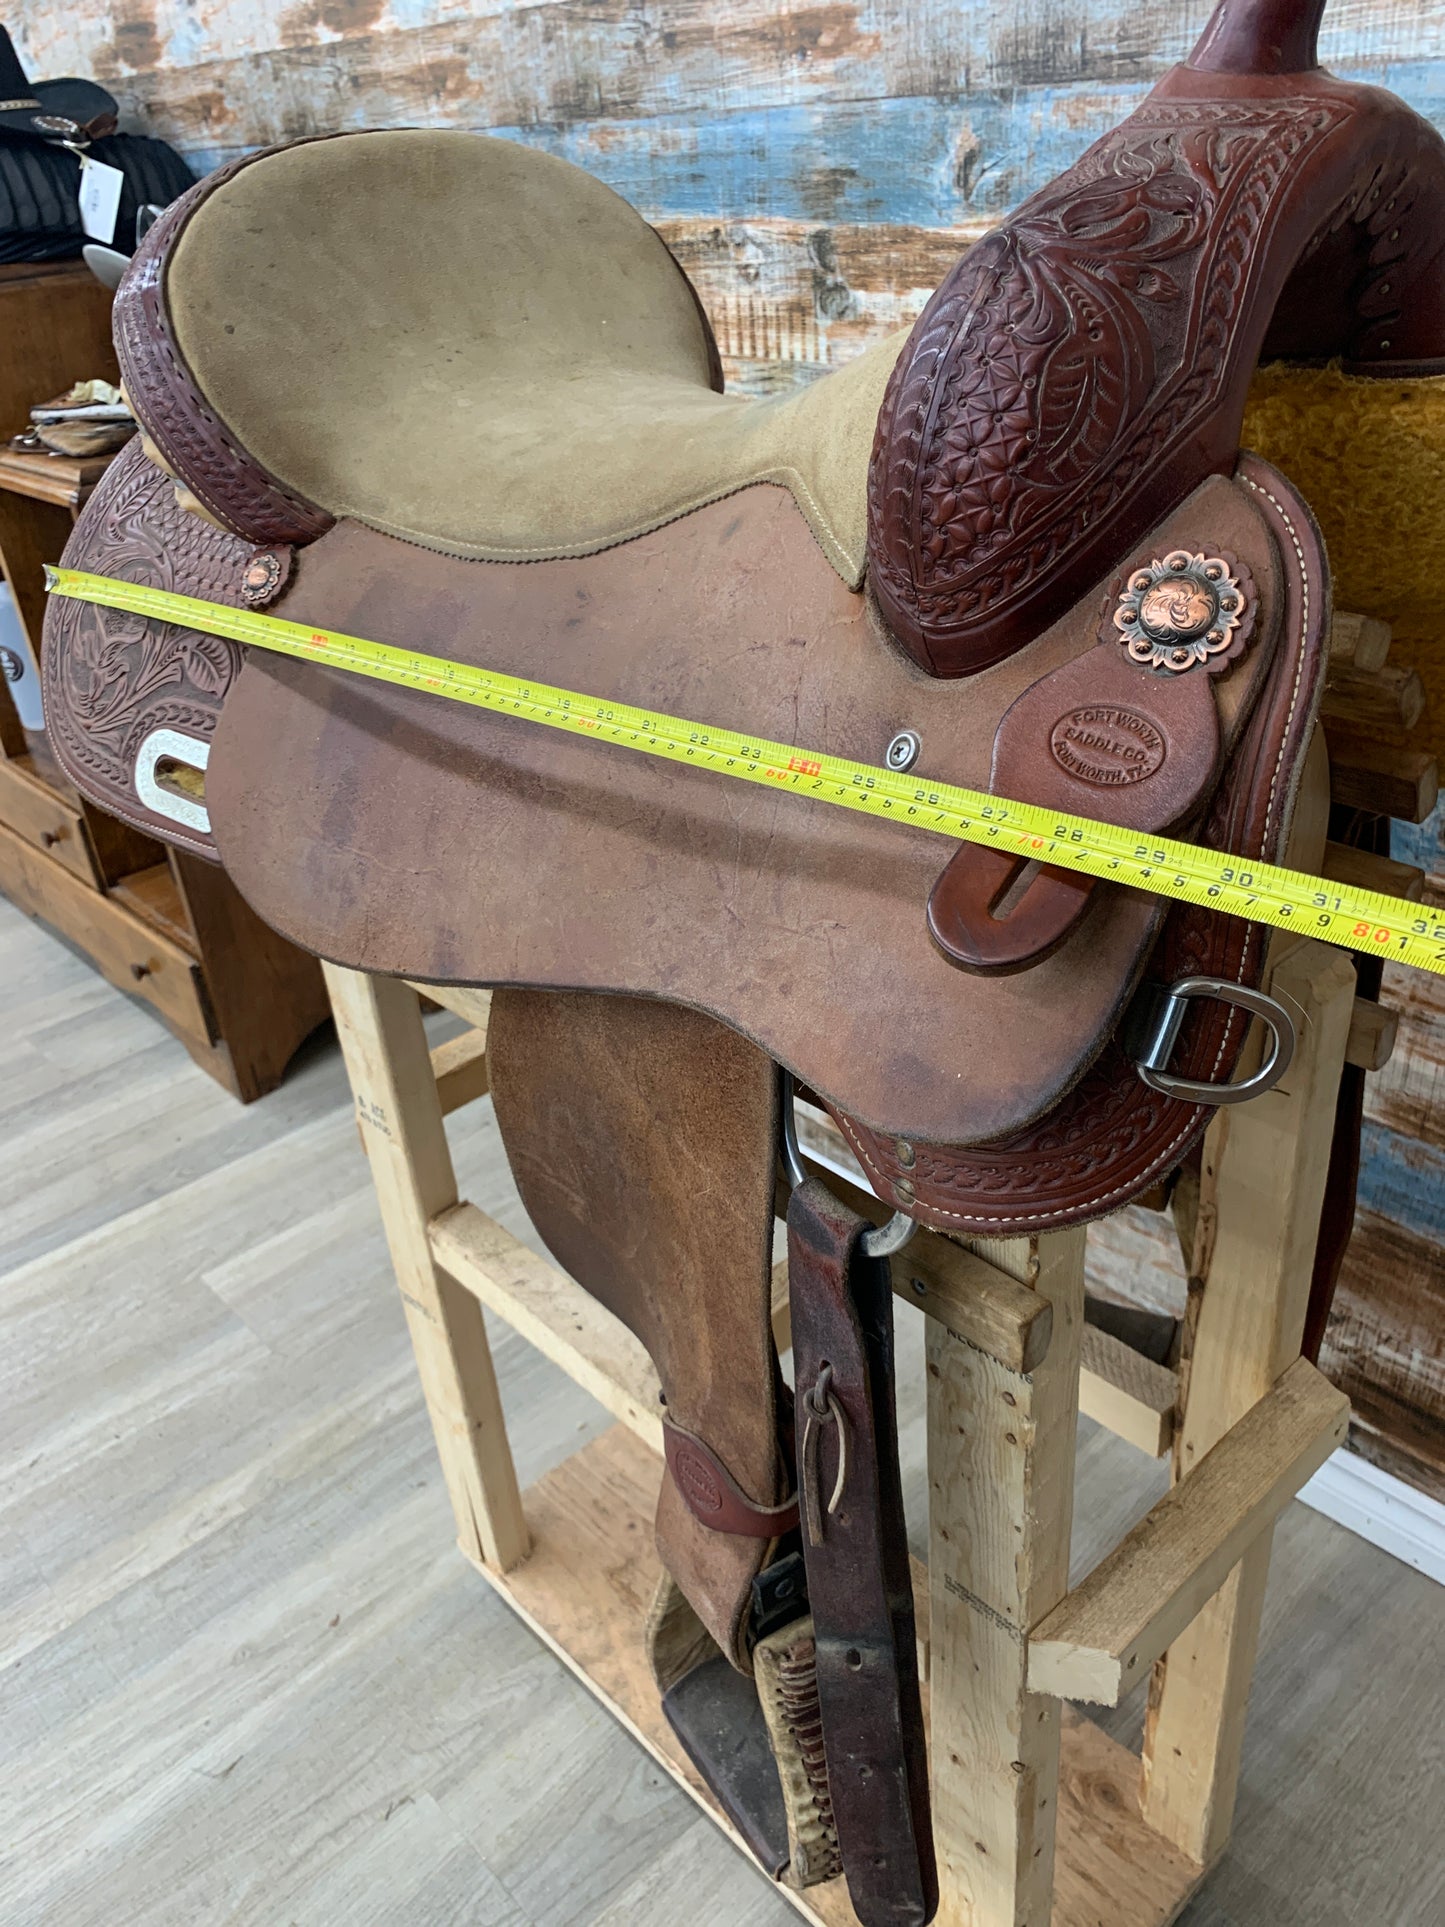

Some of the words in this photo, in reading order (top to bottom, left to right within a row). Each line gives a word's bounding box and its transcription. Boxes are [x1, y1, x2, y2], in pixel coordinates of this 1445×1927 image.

[1064, 726, 1123, 756] SADDLE
[1122, 746, 1150, 765] CO.
[1072, 710, 1117, 727] FORT
[1116, 712, 1160, 750] WORTH
[1054, 739, 1078, 768] FORT
[410, 660, 420, 670] 15
[480, 678, 492, 688] 17
[596, 708, 614, 721] 20
[641, 720, 658, 732] 21
[690, 732, 710, 746] 22
[740, 746, 762, 760] 23
[852, 774, 876, 789] 25
[980, 806, 1009, 822] 27
[1054, 825, 1083, 842] 28
[1134, 845, 1166, 864] 29
[1220, 868, 1254, 888] 30
[1312, 892, 1342, 911] 31
[578, 718, 596, 729] 50
[686, 748, 695, 756] 6
[726, 758, 736, 766] 8
[747, 763, 757, 772] 9
[766, 768, 788, 780] 60
[792, 774, 800, 784] 1
[812, 780, 823, 790] 2
[836, 786, 846, 796] 3
[858, 793, 868, 802] 4
[882, 798, 892, 808] 5
[908, 805, 917, 815] 6
[934, 812, 945, 822] 7
[960, 818, 971, 829] 8
[986, 825, 999, 836] 9
[1017, 832, 1044, 849] 70
[1048, 842, 1056, 852] 1
[1074, 849, 1088, 862] 2
[1107, 857, 1120, 870] 3
[1140, 866, 1152, 878] 4
[1172, 874, 1188, 888] 5
[1207, 884, 1222, 897] 6
[1244, 893, 1258, 906] 7
[1278, 903, 1293, 917] 8
[1316, 914, 1332, 928] 9
[1352, 922, 1391, 944] 80
[1398, 936, 1409, 950] 1
